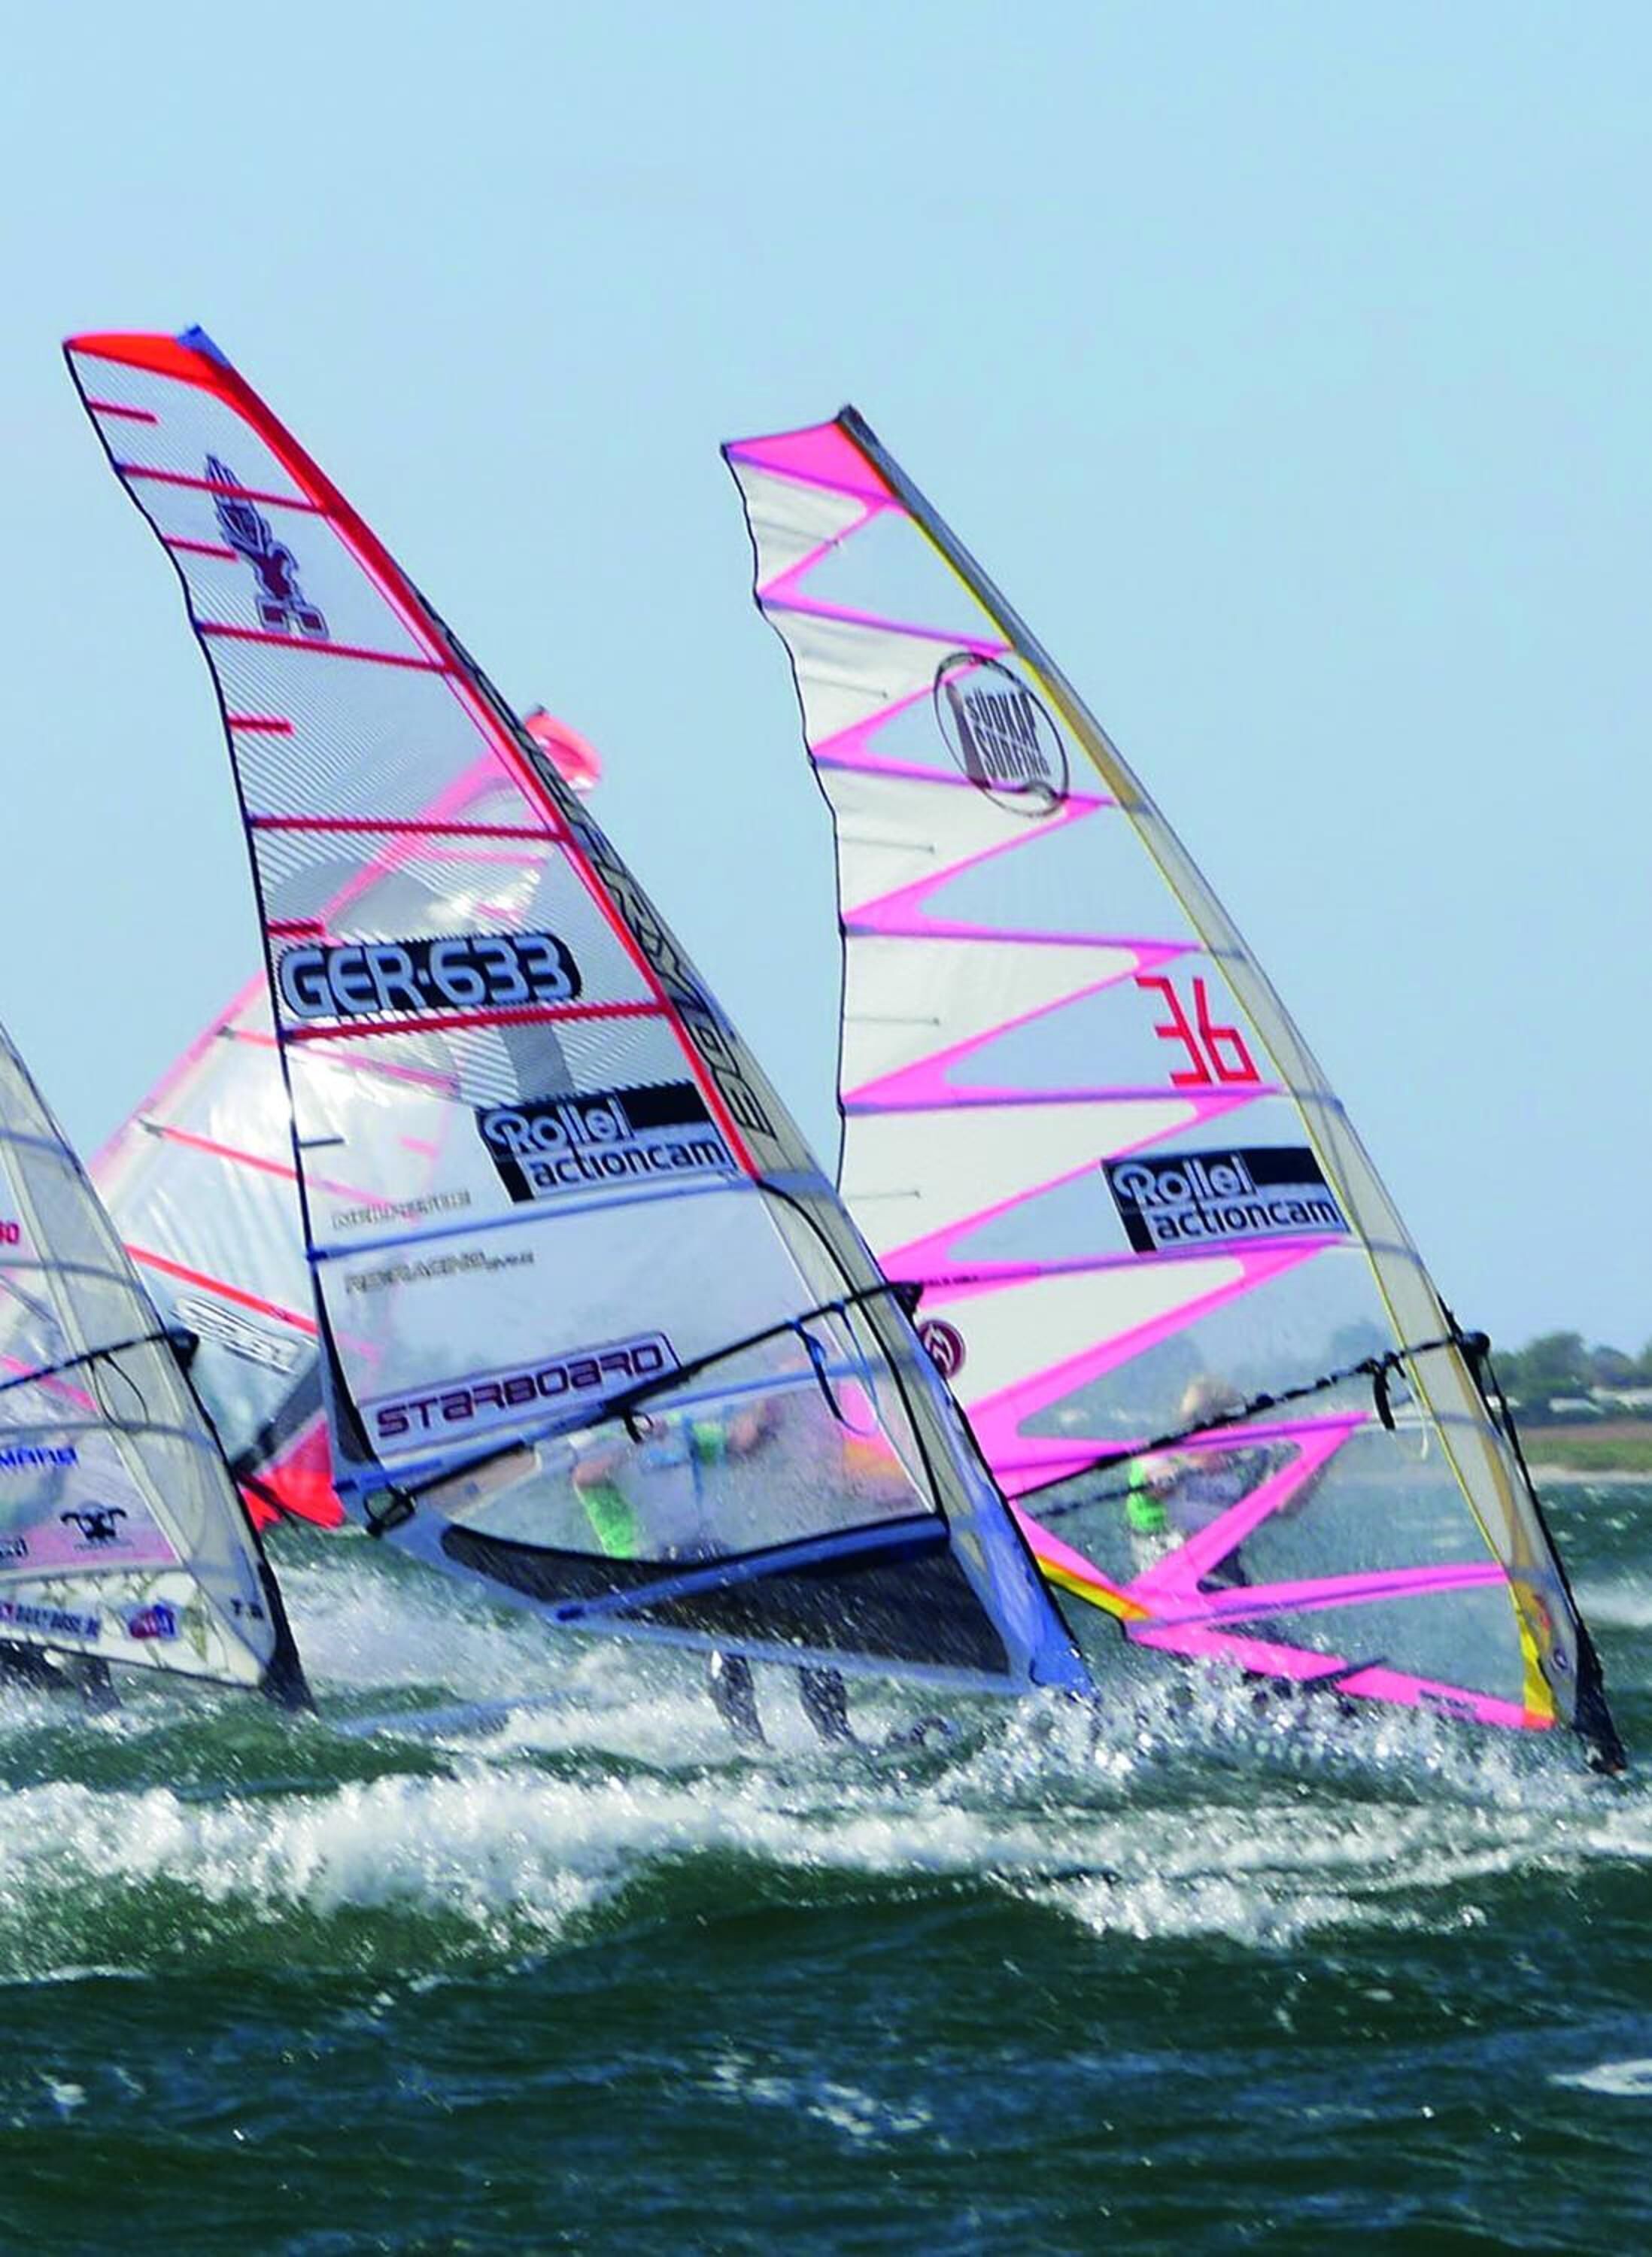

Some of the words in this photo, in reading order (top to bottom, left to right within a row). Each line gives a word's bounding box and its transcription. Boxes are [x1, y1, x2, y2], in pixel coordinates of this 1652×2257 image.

[1134, 975, 1261, 1087] 36
[530, 1139, 727, 1188] actioncam
[1155, 1198, 1340, 1242] actioncam
